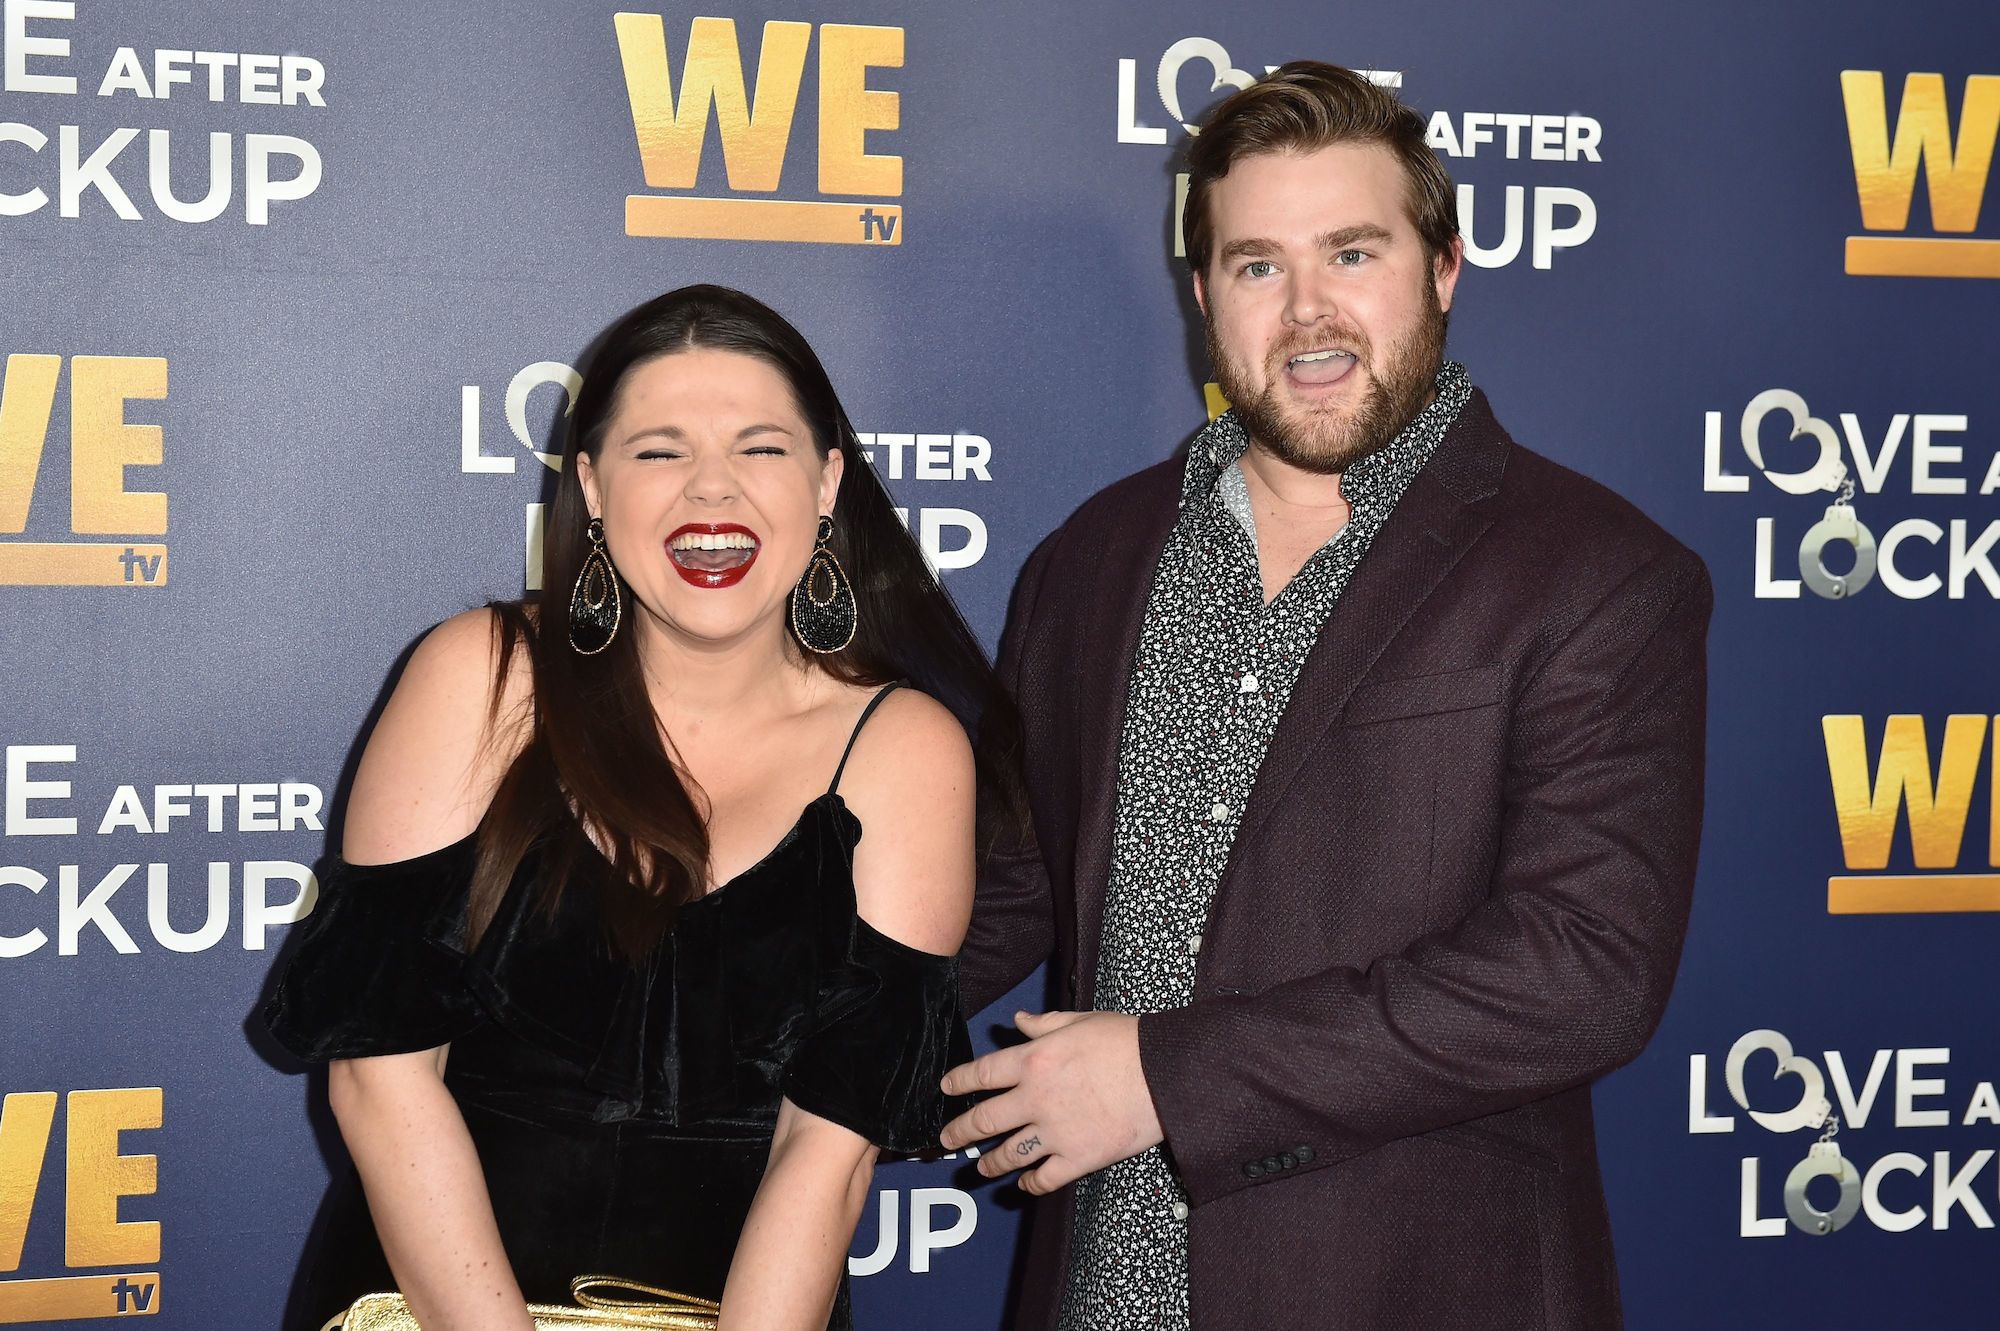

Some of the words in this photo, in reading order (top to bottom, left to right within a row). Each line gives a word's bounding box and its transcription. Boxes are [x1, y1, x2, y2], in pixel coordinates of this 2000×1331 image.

[98, 47, 327, 107] AFTER
[613, 12, 904, 197] WE
[1424, 110, 1602, 162] AFTER
[859, 207, 898, 243] tv
[1703, 388, 1968, 496] LOVE
[119, 548, 163, 583] tv
[1754, 504, 2000, 600] LOCK
[97, 783, 324, 834] AFTER
[1688, 1029, 1951, 1134] LOVE
[111, 1278, 158, 1315] tv
